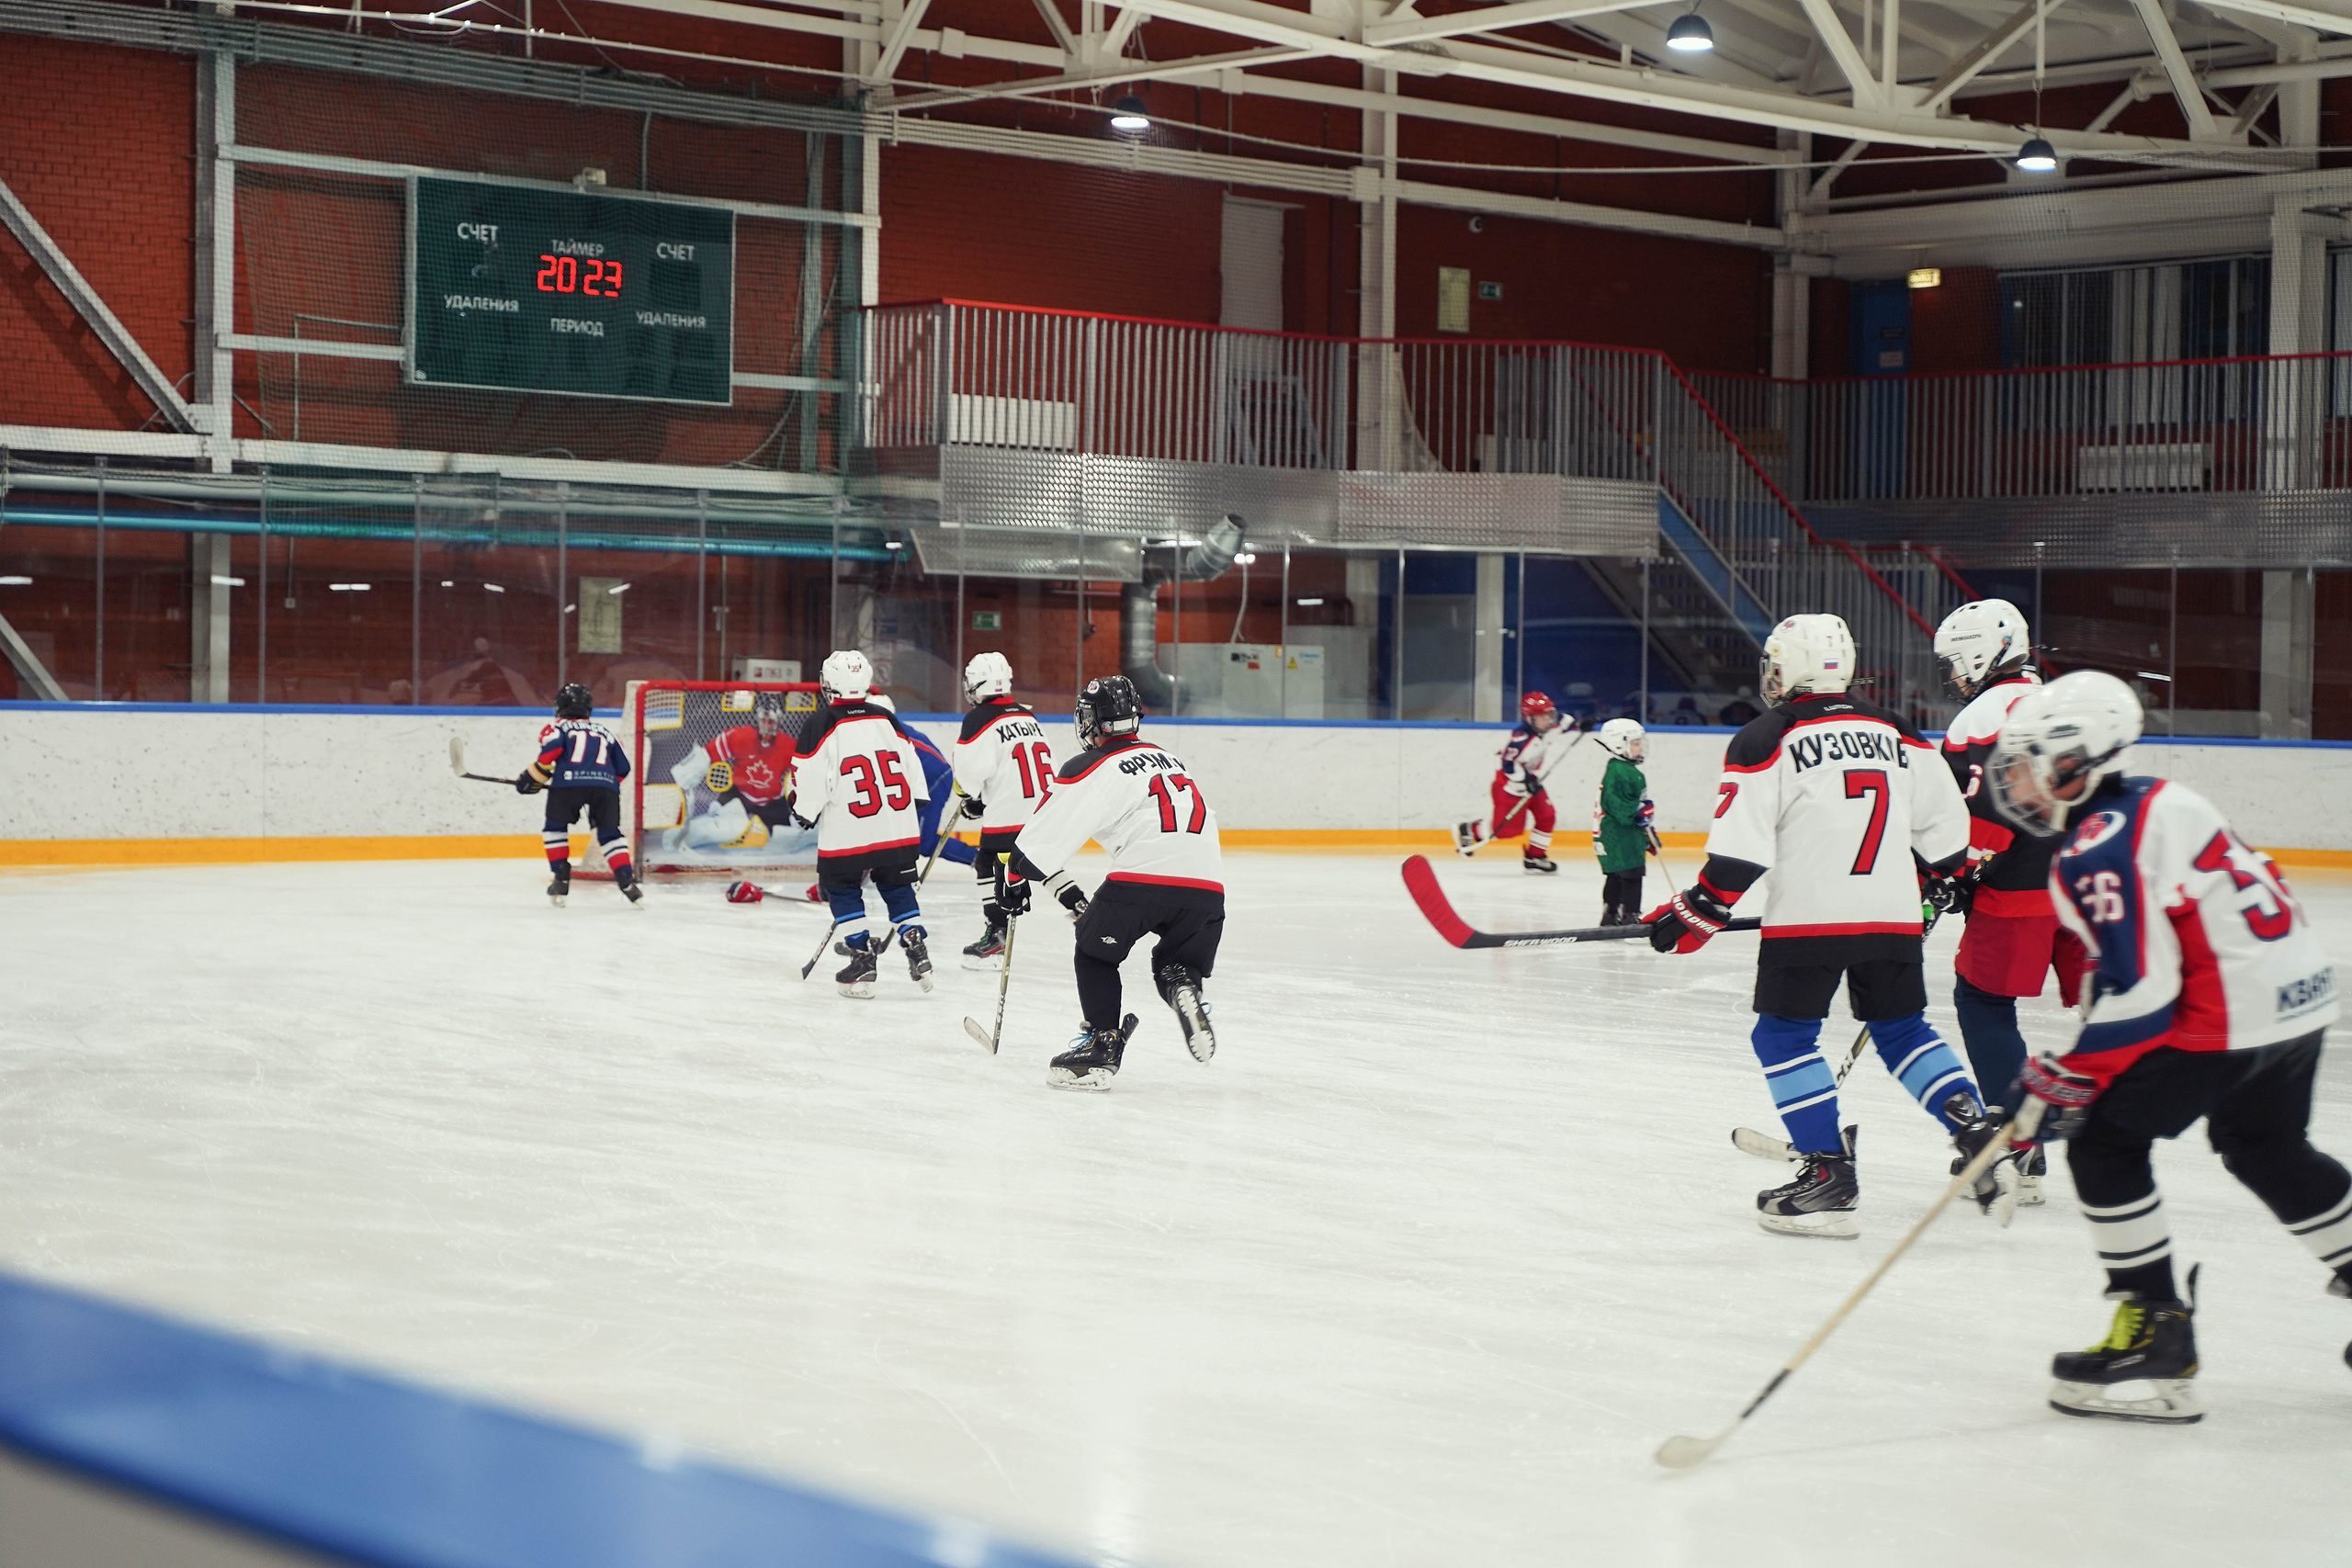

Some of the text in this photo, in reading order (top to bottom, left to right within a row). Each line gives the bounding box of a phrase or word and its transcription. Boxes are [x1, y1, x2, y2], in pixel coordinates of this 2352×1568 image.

[457, 222, 498, 242] СЧЕТ
[551, 239, 605, 257] ТАЙМЕР
[656, 243, 695, 261] СЧЕТ
[444, 294, 519, 312] УДАЛЕНИЯ
[551, 318, 605, 337] ПЕРИОД
[636, 311, 707, 329] УДАЛЕНИЯ
[1012, 741, 1057, 799] 16
[840, 750, 911, 818] 35
[1148, 773, 1206, 835] 17
[1713, 782, 1738, 819] 7
[1843, 768, 1890, 875] 7
